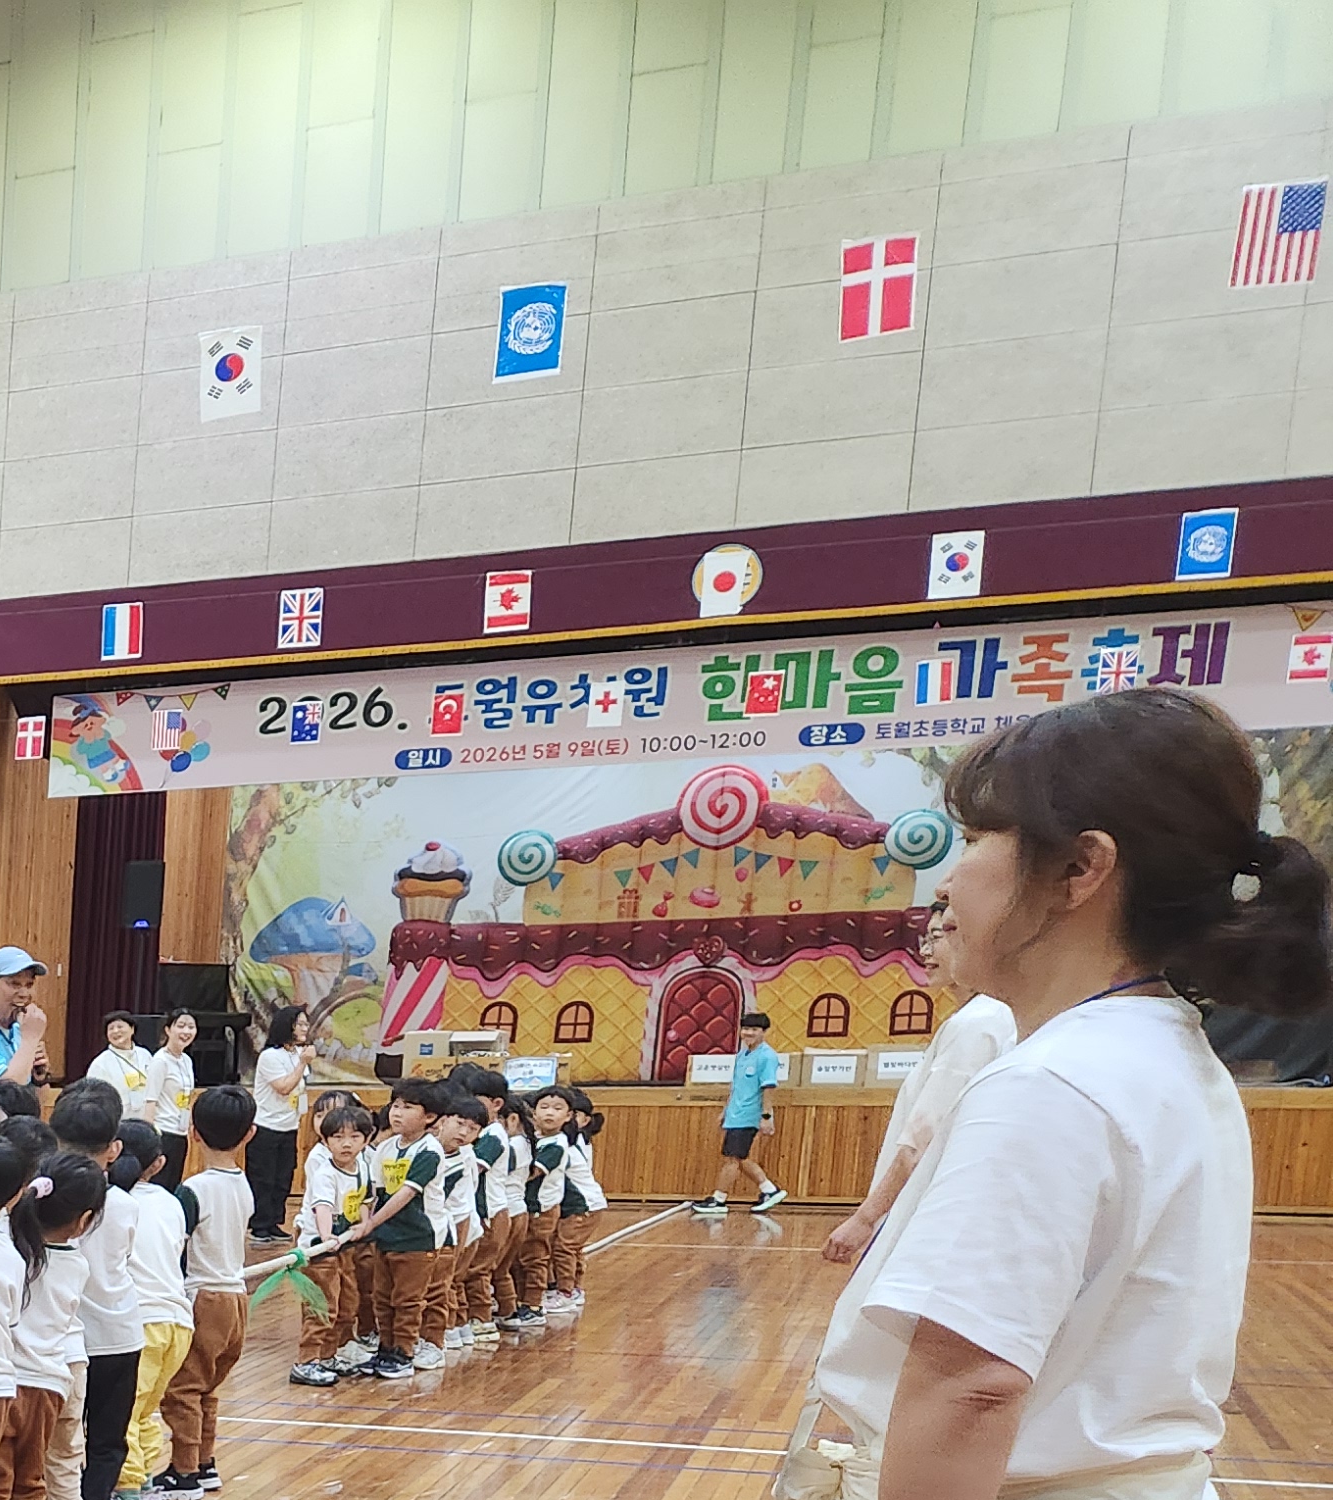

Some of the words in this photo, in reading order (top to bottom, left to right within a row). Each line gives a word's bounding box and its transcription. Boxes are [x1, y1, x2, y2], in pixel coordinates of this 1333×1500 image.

[701, 645, 903, 722] 한마음
[809, 725, 847, 744] 장소
[875, 717, 986, 740] 토월초등학교
[994, 714, 1031, 733] 체
[407, 749, 441, 768] 일시
[460, 744, 526, 764] 2026년
[533, 742, 561, 760] 5월
[567, 738, 630, 758] 9일(토)
[640, 730, 766, 753] 10:00~12:00
